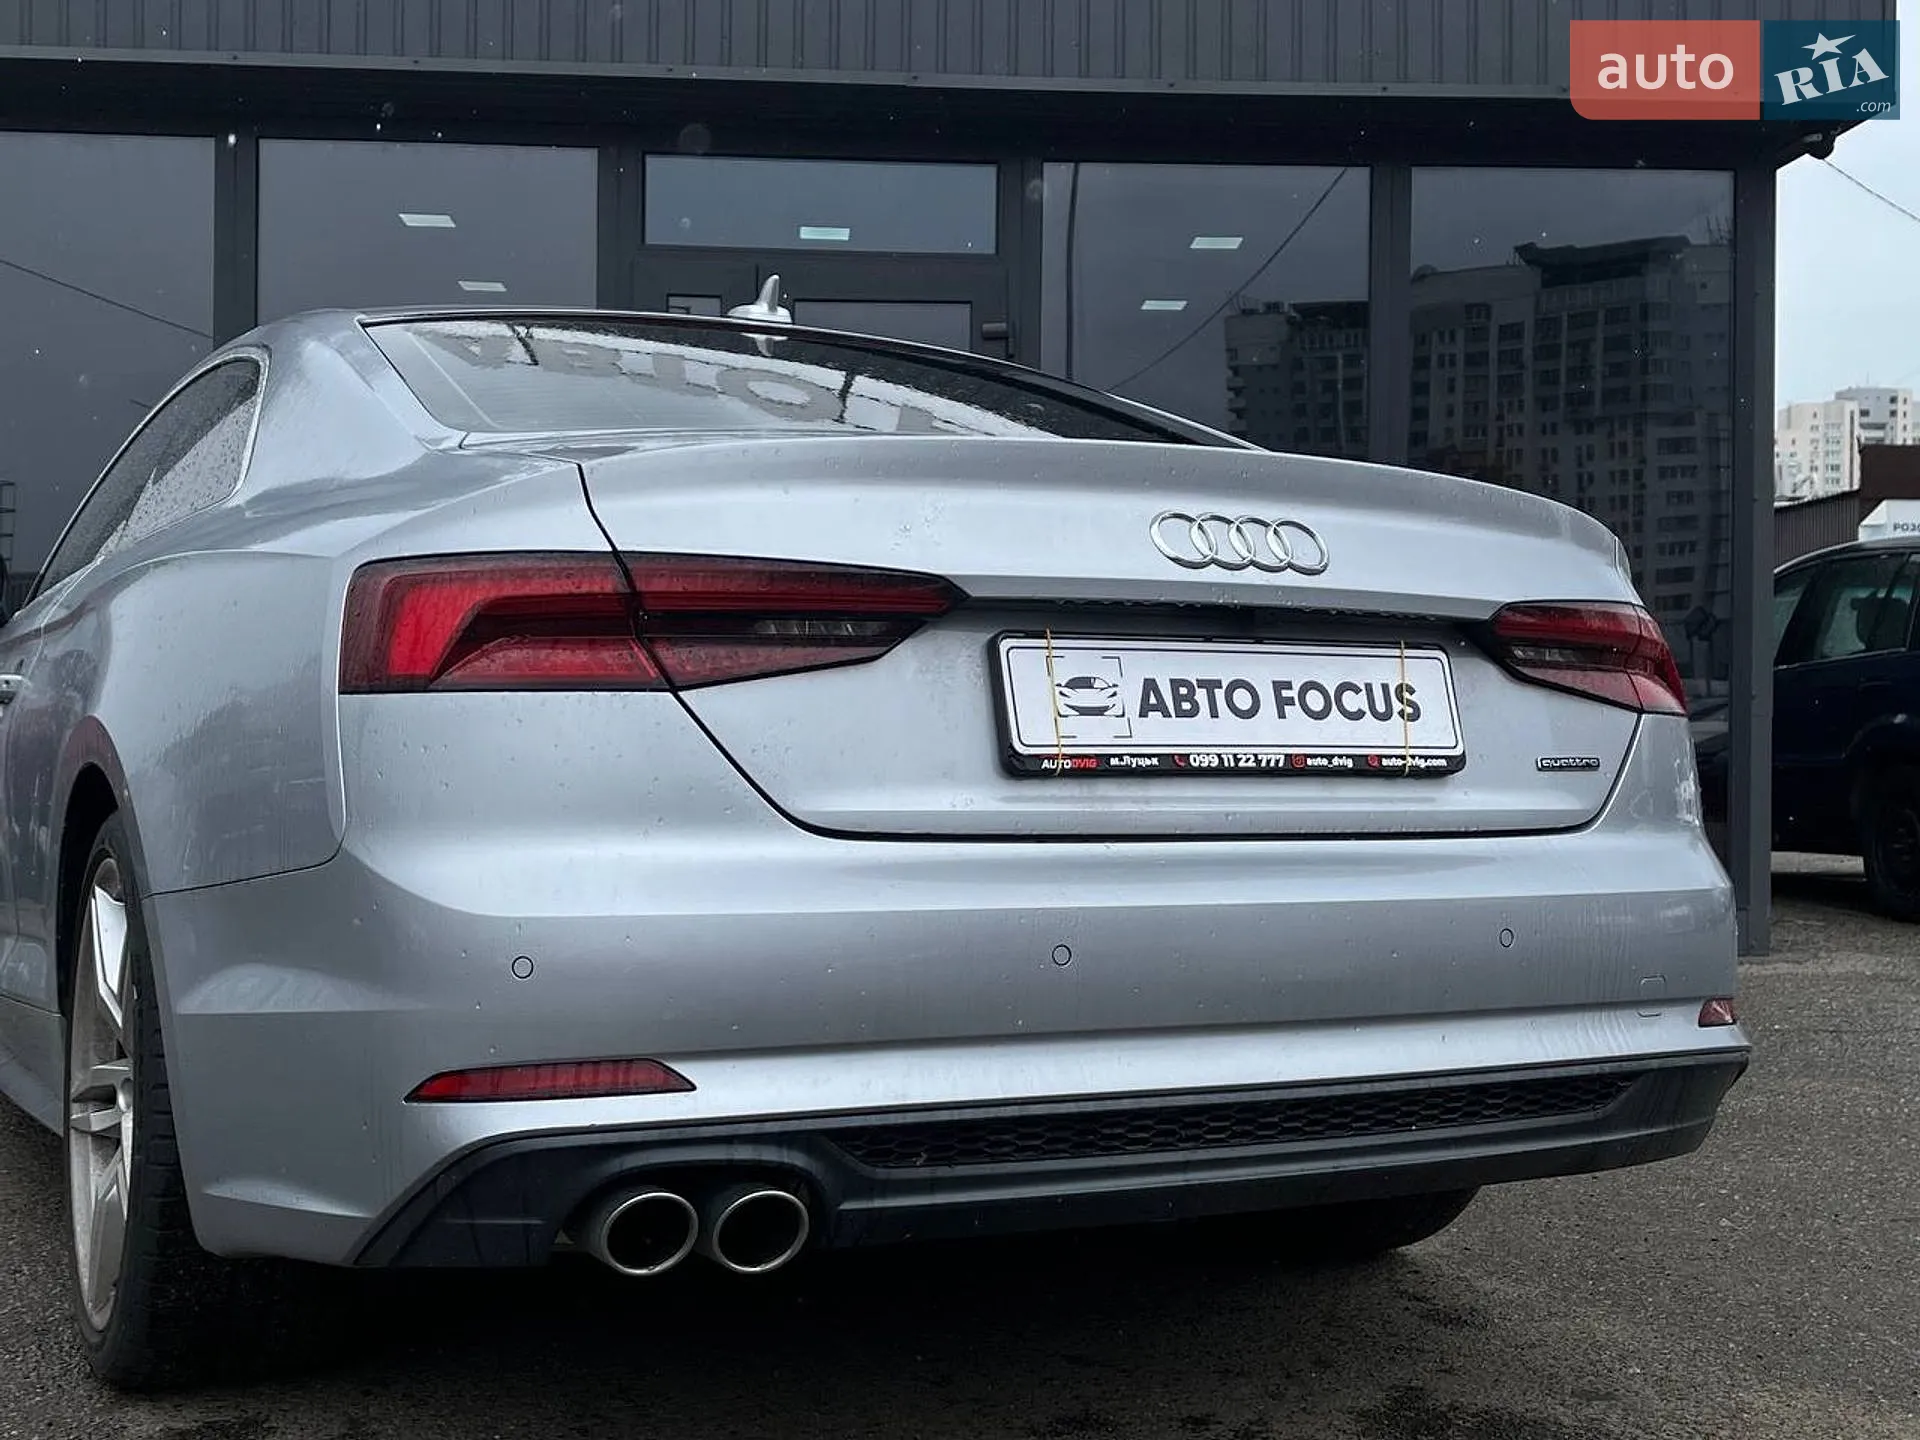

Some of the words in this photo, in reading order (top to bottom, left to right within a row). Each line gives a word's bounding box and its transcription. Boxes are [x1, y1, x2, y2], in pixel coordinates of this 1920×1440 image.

[1138, 677, 1261, 720] АВТО
[1272, 680, 1422, 723] FOCUS
[1190, 754, 1219, 767] 099
[1221, 754, 1235, 767] 11
[1237, 754, 1257, 768] 22
[1258, 754, 1286, 768] 777
[1540, 757, 1600, 769] quattro
